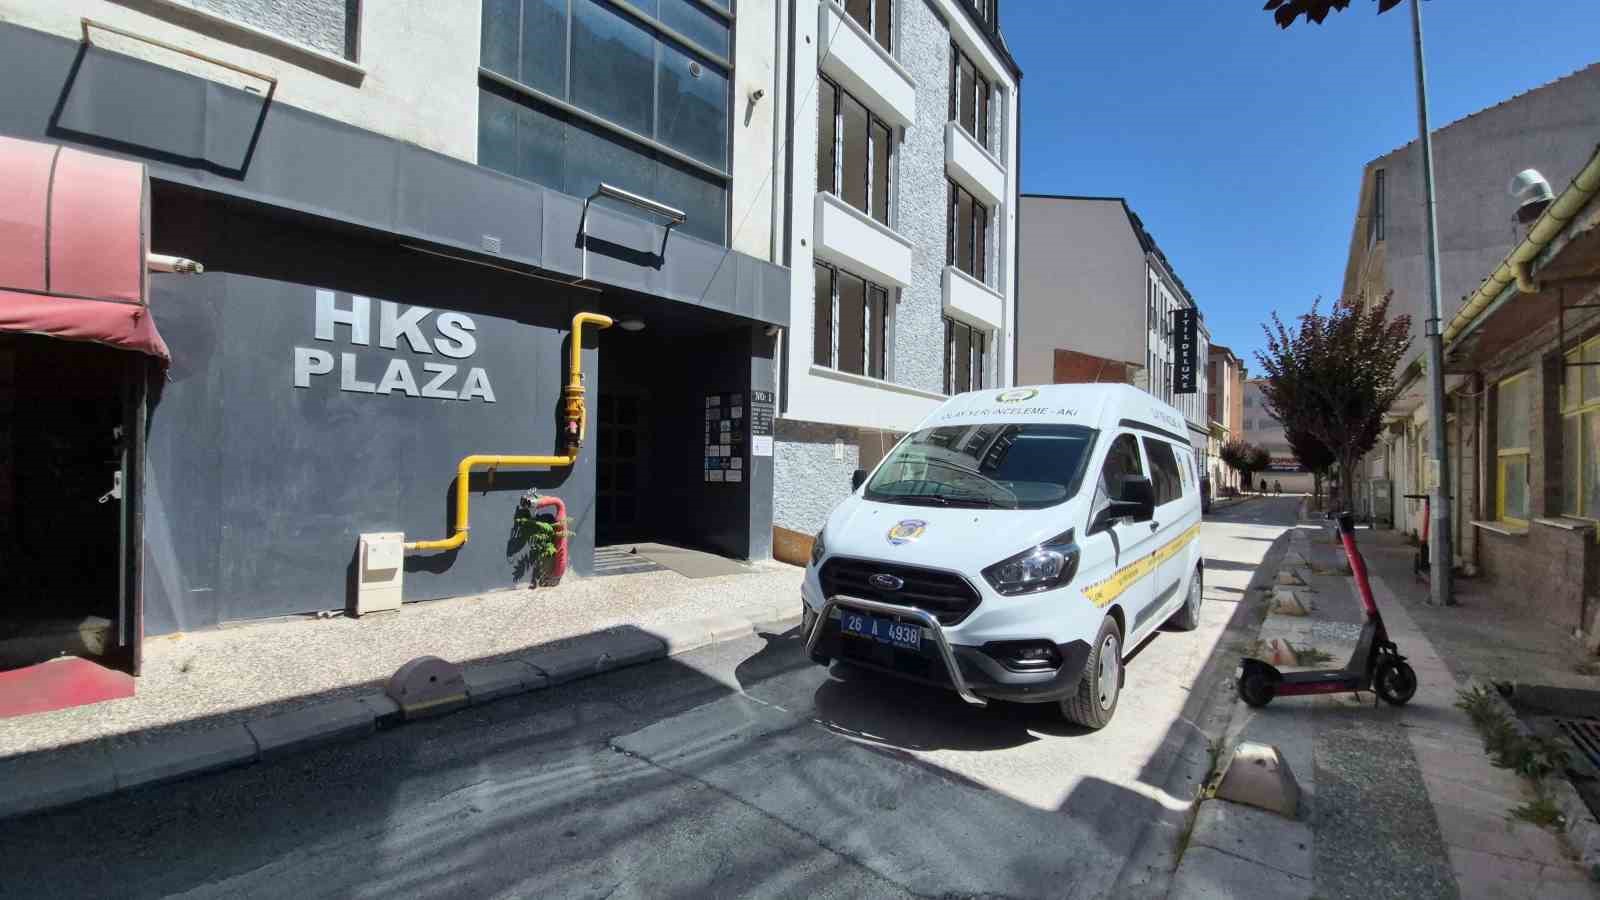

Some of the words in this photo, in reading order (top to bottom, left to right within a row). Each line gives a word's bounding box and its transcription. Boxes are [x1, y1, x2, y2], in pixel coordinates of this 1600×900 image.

[314, 288, 478, 359] HKS
[294, 347, 497, 403] PLAZA
[848, 615, 862, 632] 26
[871, 619, 879, 636] A
